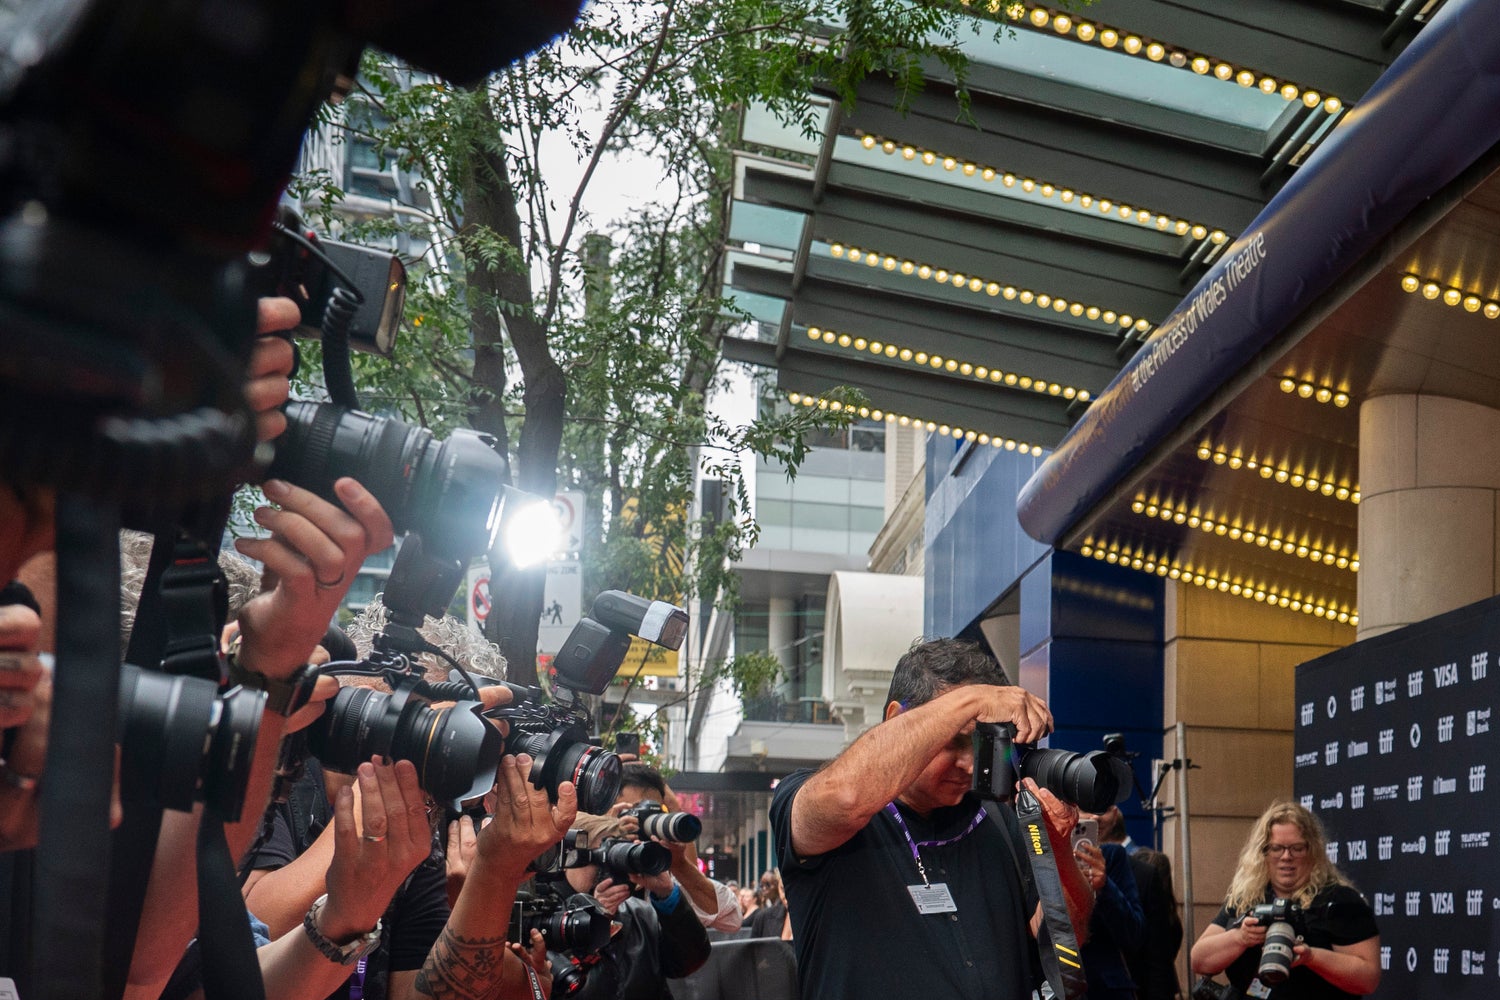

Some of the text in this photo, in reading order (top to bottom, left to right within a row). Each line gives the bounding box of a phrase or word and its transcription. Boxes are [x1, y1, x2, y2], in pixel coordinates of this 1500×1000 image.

[1153, 317, 1188, 370] Princess
[1195, 277, 1227, 322] Wales
[1225, 232, 1266, 292] Theatre
[1434, 663, 1458, 688] VISA
[1351, 686, 1364, 711] tiff
[1301, 703, 1313, 726] tiff
[1379, 729, 1393, 754] tiff
[1438, 716, 1453, 742] tiff
[1028, 824, 1044, 855] Nikon
